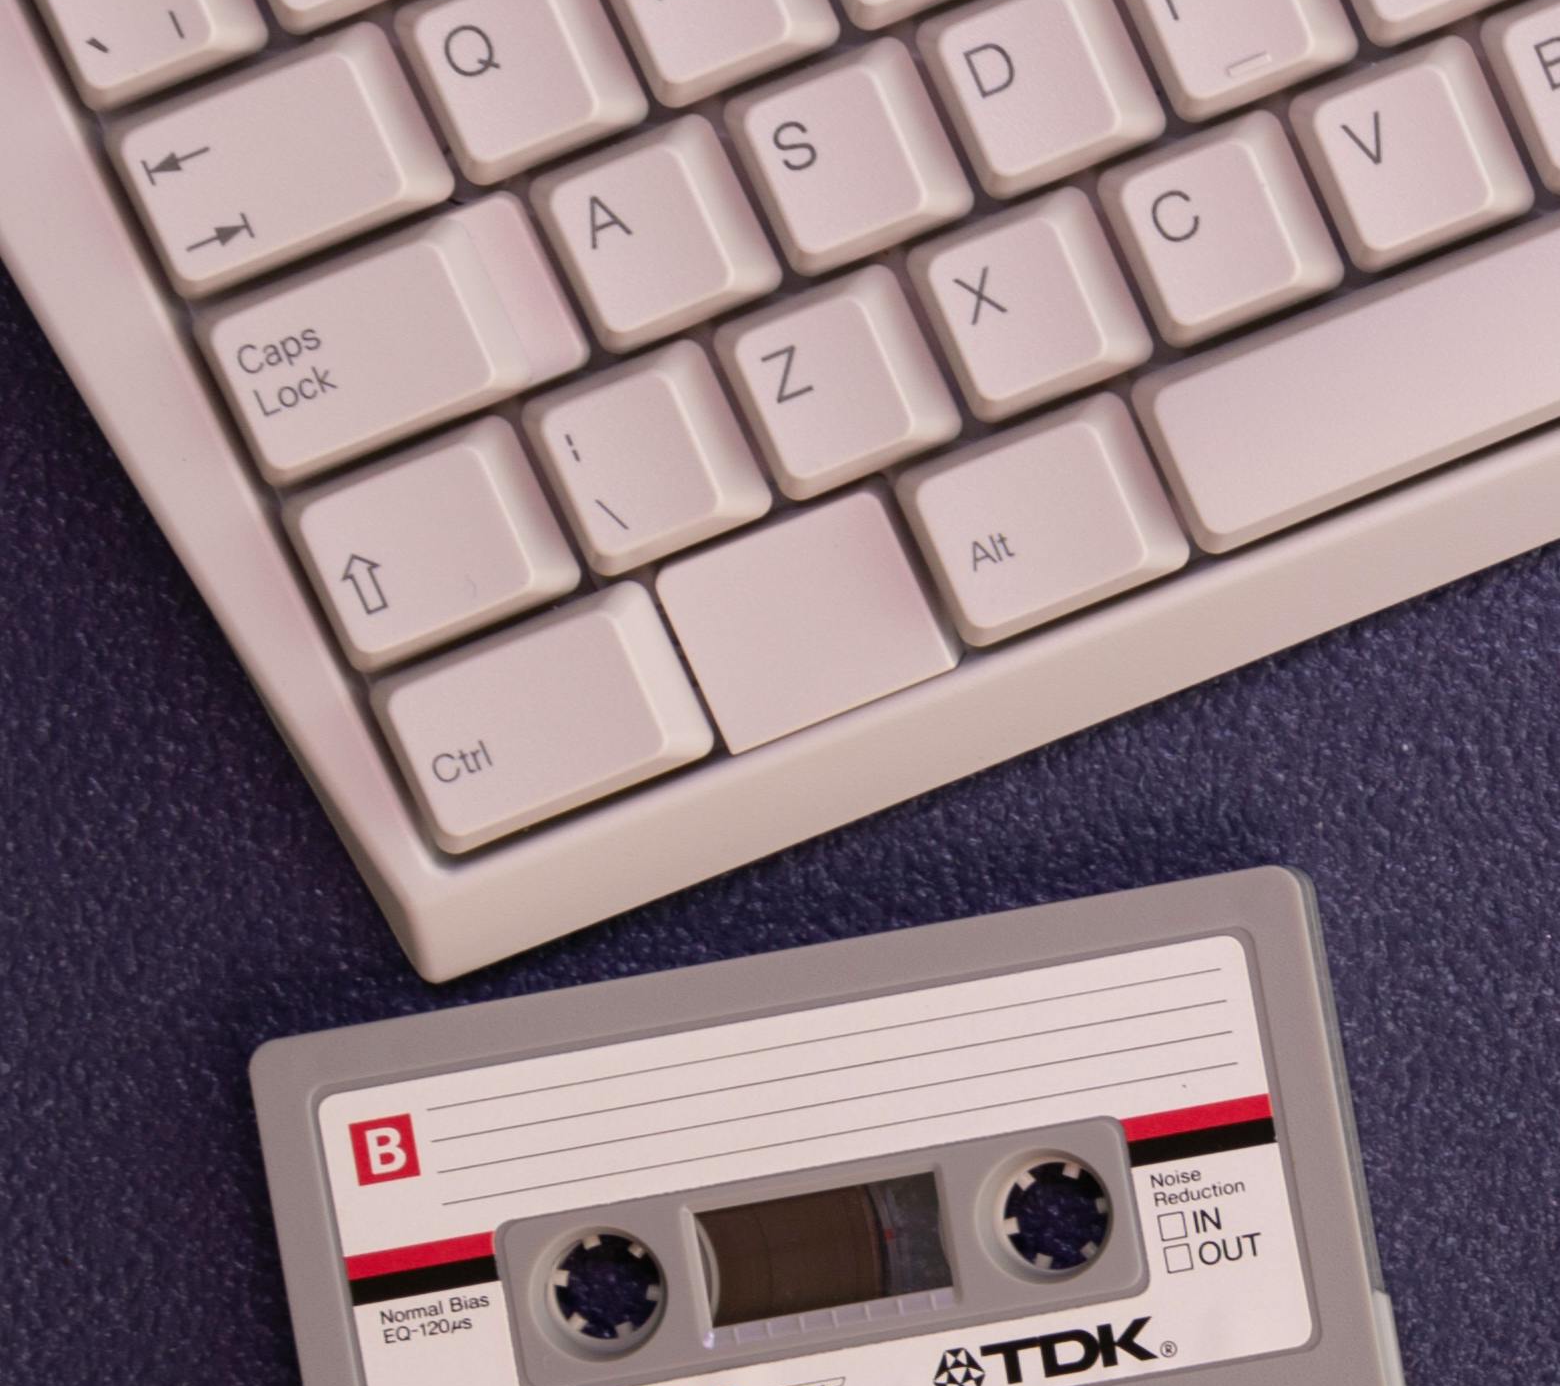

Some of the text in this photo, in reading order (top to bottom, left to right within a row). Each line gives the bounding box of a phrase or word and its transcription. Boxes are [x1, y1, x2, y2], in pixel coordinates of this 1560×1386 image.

[443, 24, 501, 78] Q
[962, 42, 1016, 99] D
[772, 120, 818, 171] S
[1340, 110, 1383, 166] V
[589, 195, 633, 250] A
[1151, 189, 1200, 243] C
[953, 266, 1008, 326] X
[236, 328, 322, 375] Caps
[760, 344, 815, 405] Z
[252, 366, 338, 418] Lock
[971, 532, 1016, 572] Alt
[431, 740, 493, 784] Ctrl
[365, 1126, 408, 1175] B
[1149, 1169, 1201, 1189] Noise
[1153, 1181, 1246, 1207] Reduction
[1192, 1207, 1222, 1234] IN
[1198, 1232, 1261, 1266] OUT
[379, 1295, 490, 1325] Normal Bias
